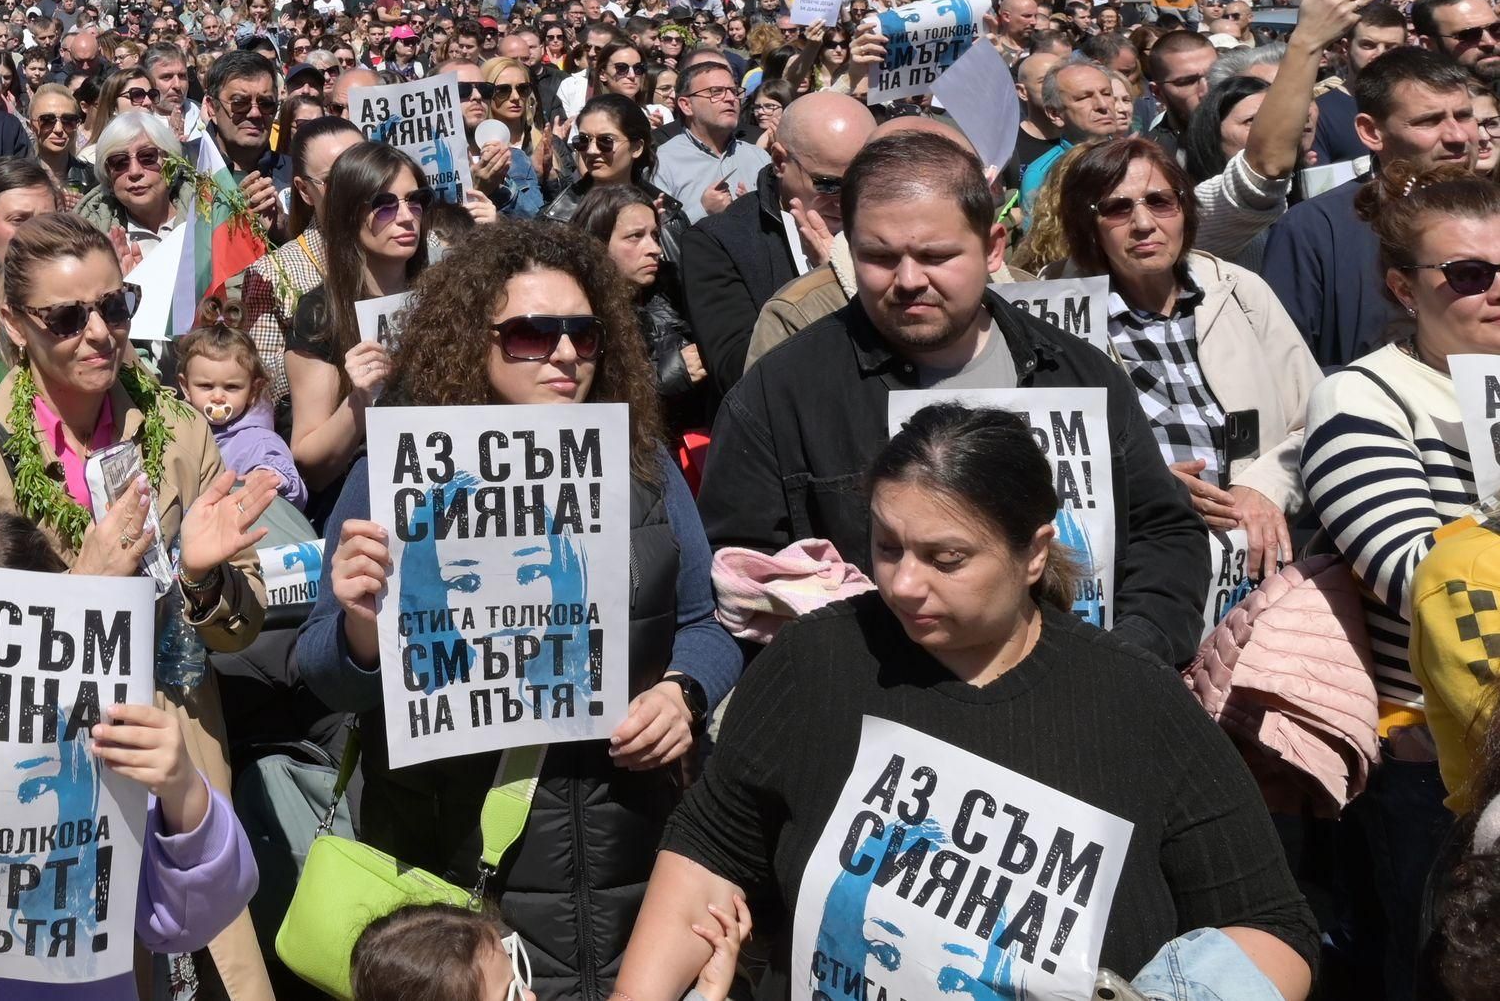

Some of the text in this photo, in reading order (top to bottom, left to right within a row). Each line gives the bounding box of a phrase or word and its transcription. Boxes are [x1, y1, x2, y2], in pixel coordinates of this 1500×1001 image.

[883, 23, 979, 45] ТИГА ТОЛКОВА
[879, 65, 949, 91] НА ПЪТ
[361, 85, 452, 123] АЗ СЪМ
[392, 428, 603, 484] АЗ СЪМ
[1012, 411, 1091, 456] ЪМ
[394, 483, 602, 543] СИЯНА!
[1217, 549, 1246, 586] АЗ
[269, 580, 319, 604] ТОЛКО
[398, 603, 601, 637] СТИГА ТОЛКОВА
[402, 633, 574, 692] СМЪРТ
[408, 694, 455, 739] НА
[861, 753, 1105, 908] АЗ СЪМ
[839, 810, 1079, 975] СИЯНА!
